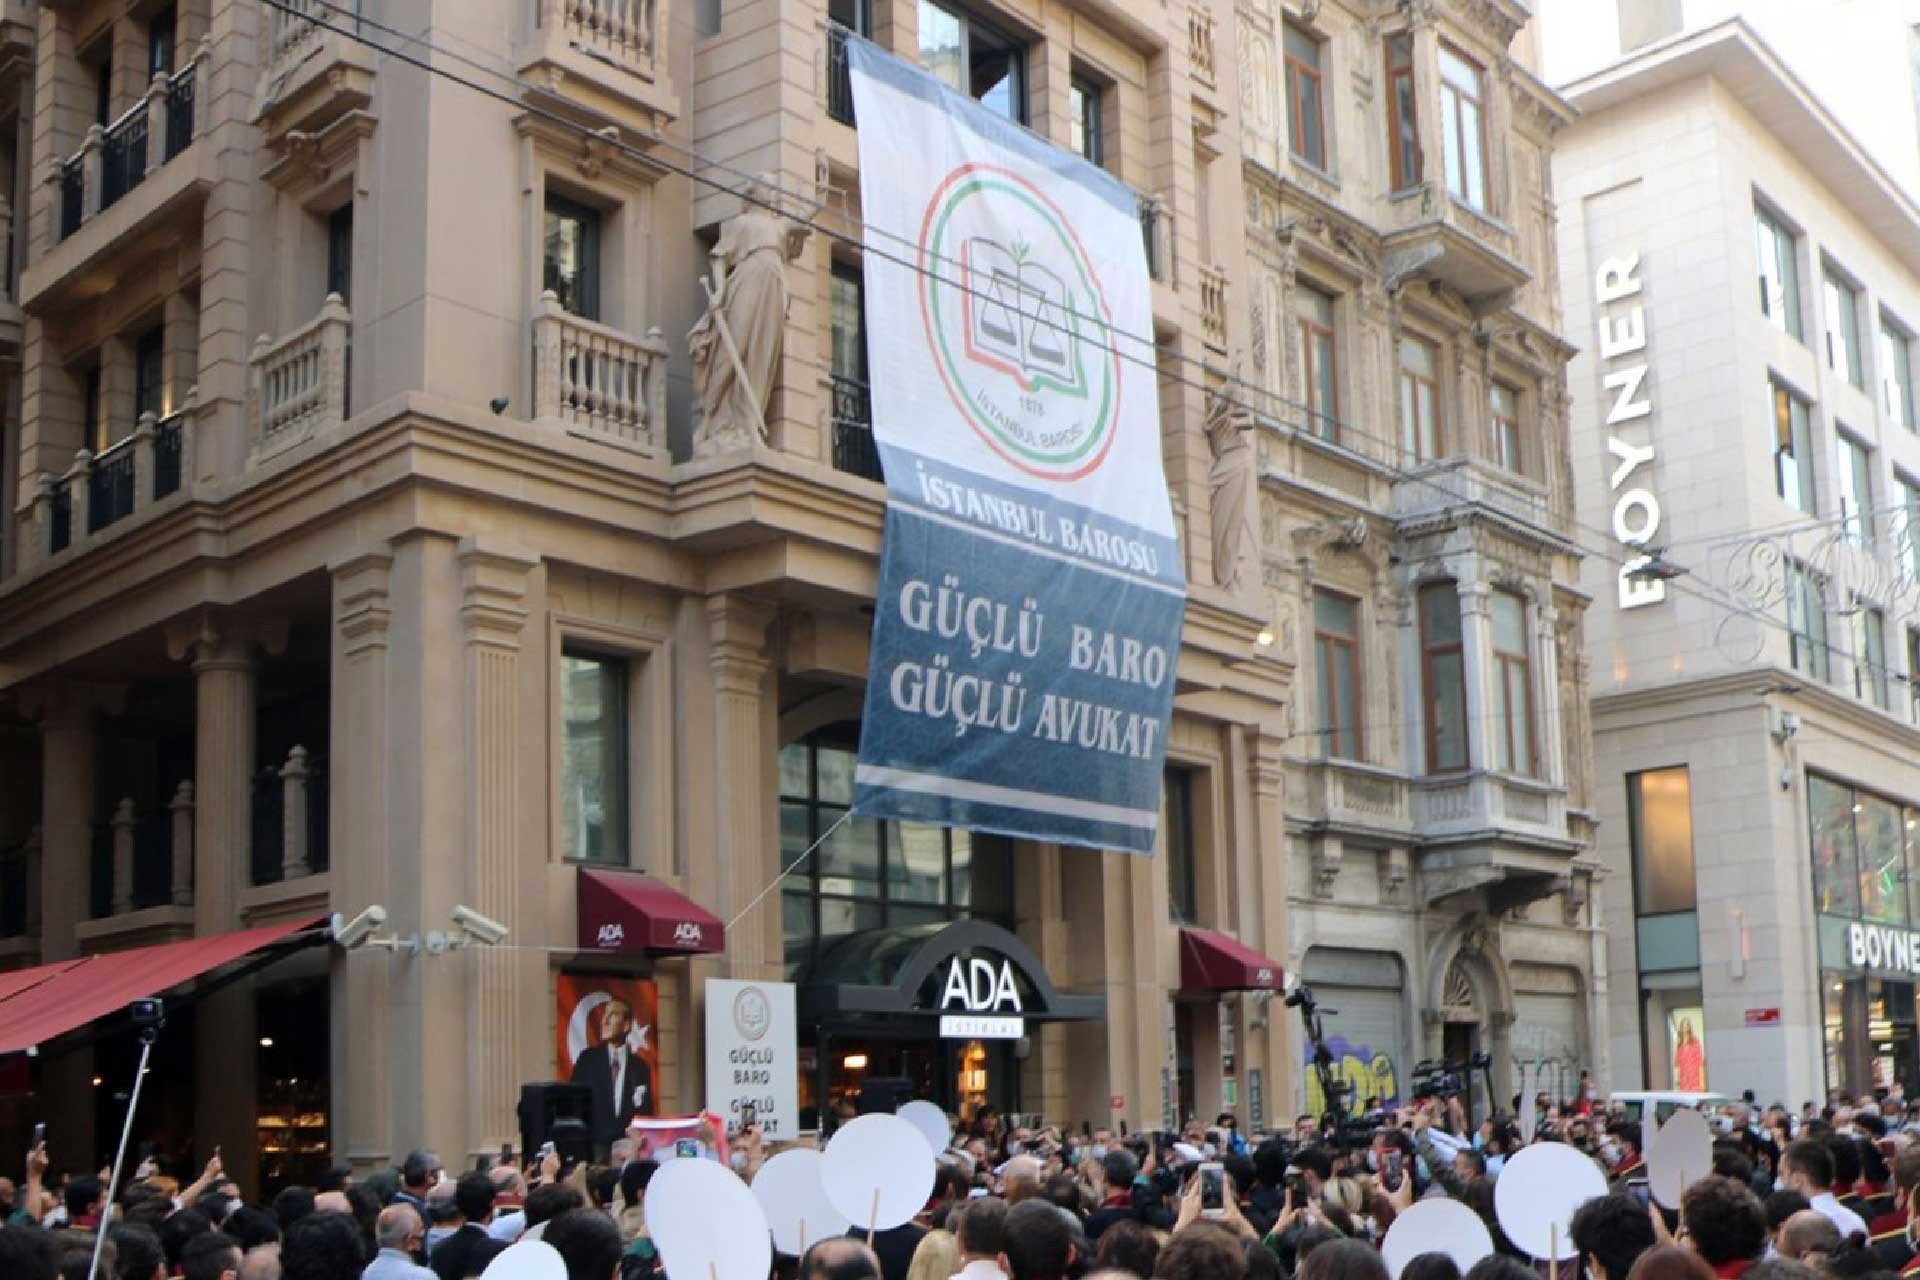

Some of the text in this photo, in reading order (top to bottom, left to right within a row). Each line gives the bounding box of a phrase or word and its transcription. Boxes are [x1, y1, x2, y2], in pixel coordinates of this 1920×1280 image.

[916, 459, 1158, 575] İSTANBUL BAROSU
[899, 573, 1167, 688] GÜÇLÜ BARO
[890, 654, 1159, 759] GÜÇLÜ AVUKAT
[673, 921, 702, 941] ADA
[941, 955, 1022, 1012] ADA
[734, 1070, 770, 1085] BARO
